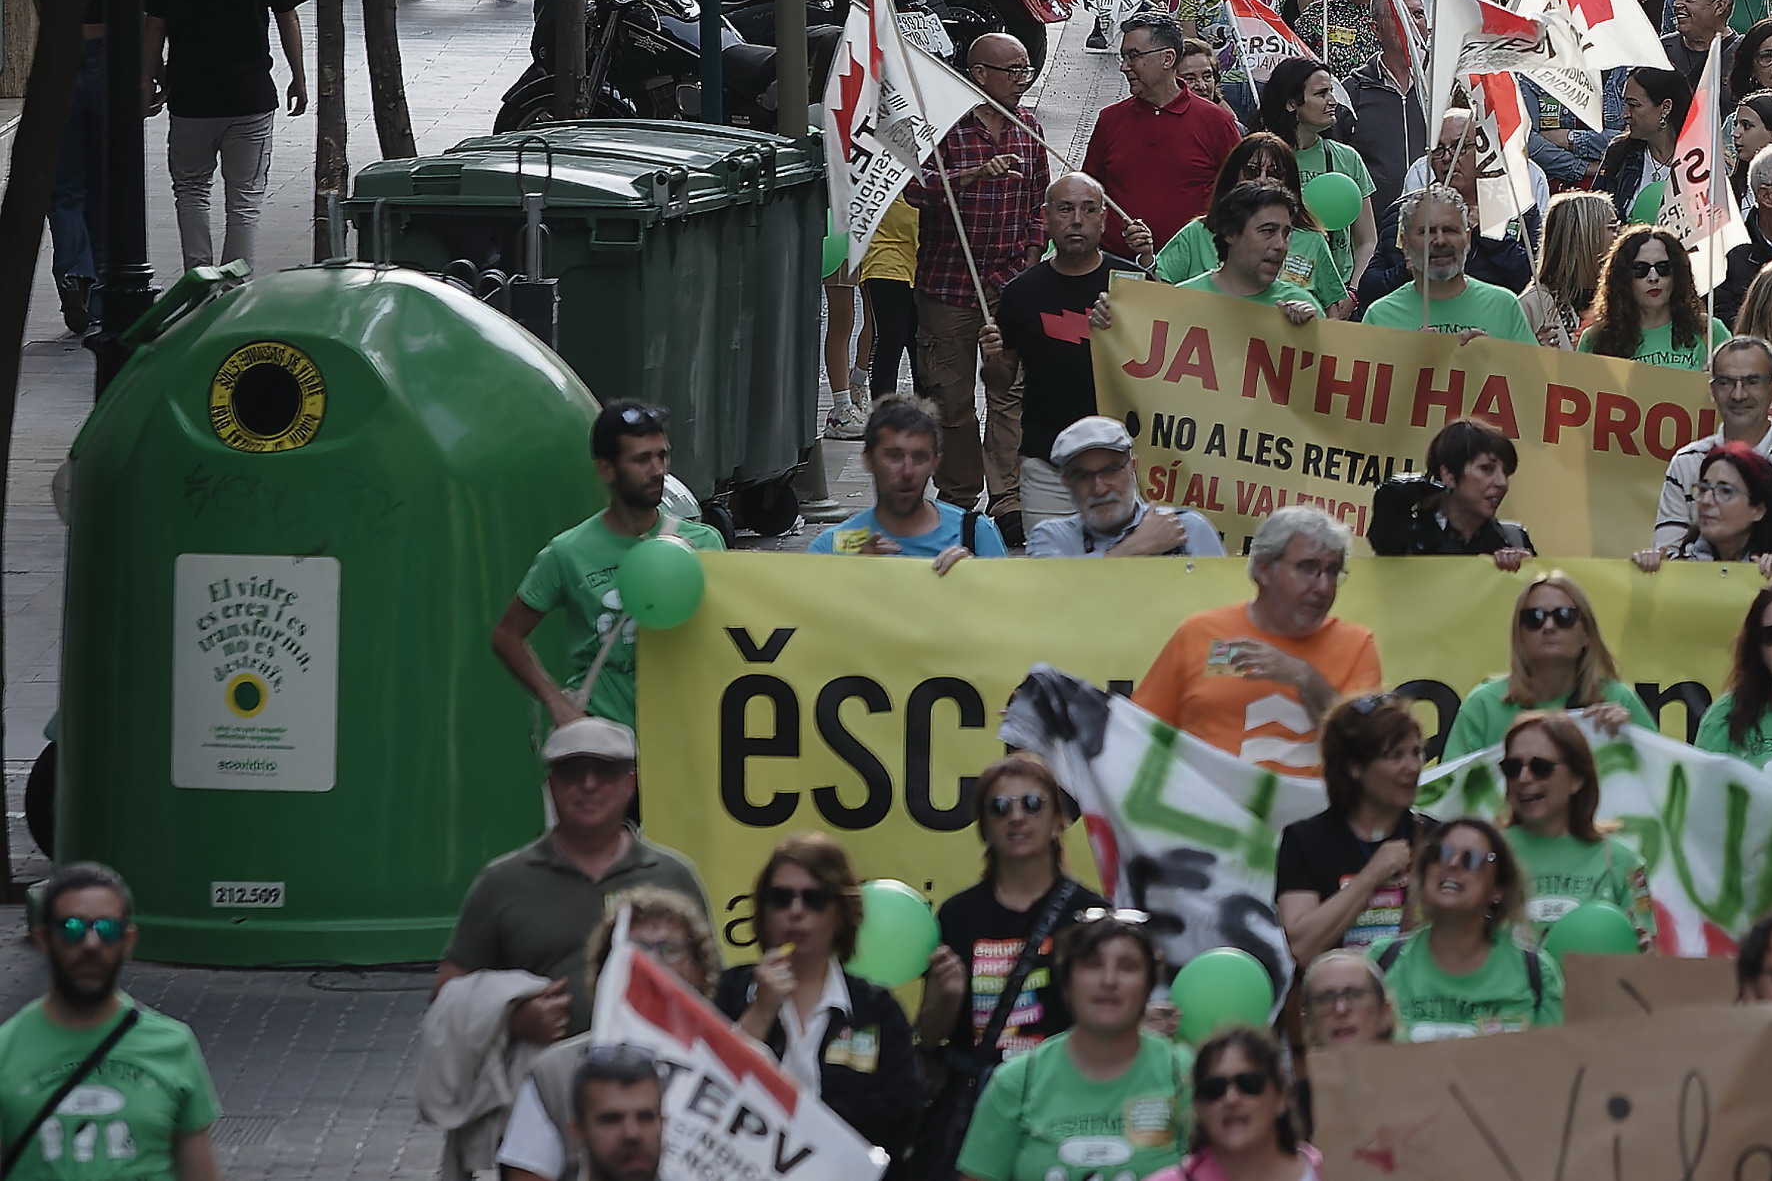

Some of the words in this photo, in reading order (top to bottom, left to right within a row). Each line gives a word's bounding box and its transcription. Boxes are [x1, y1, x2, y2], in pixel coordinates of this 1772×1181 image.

[1528, 69, 1592, 110] LENCIANA
[1555, 66, 1596, 95] INDICAL
[1474, 125, 1507, 179] PV
[1121, 318, 1220, 392] JA
[1241, 336, 1395, 425] N'HI
[1410, 366, 1520, 441] HA
[1151, 412, 1197, 453] NO
[1204, 422, 1227, 459] A
[1236, 431, 1294, 471] LES
[1146, 459, 1182, 503] SÍ
[1183, 471, 1226, 513] AL
[208, 578, 233, 603] El
[235, 575, 299, 607] vidre
[654, 1058, 813, 1175] TEPV
